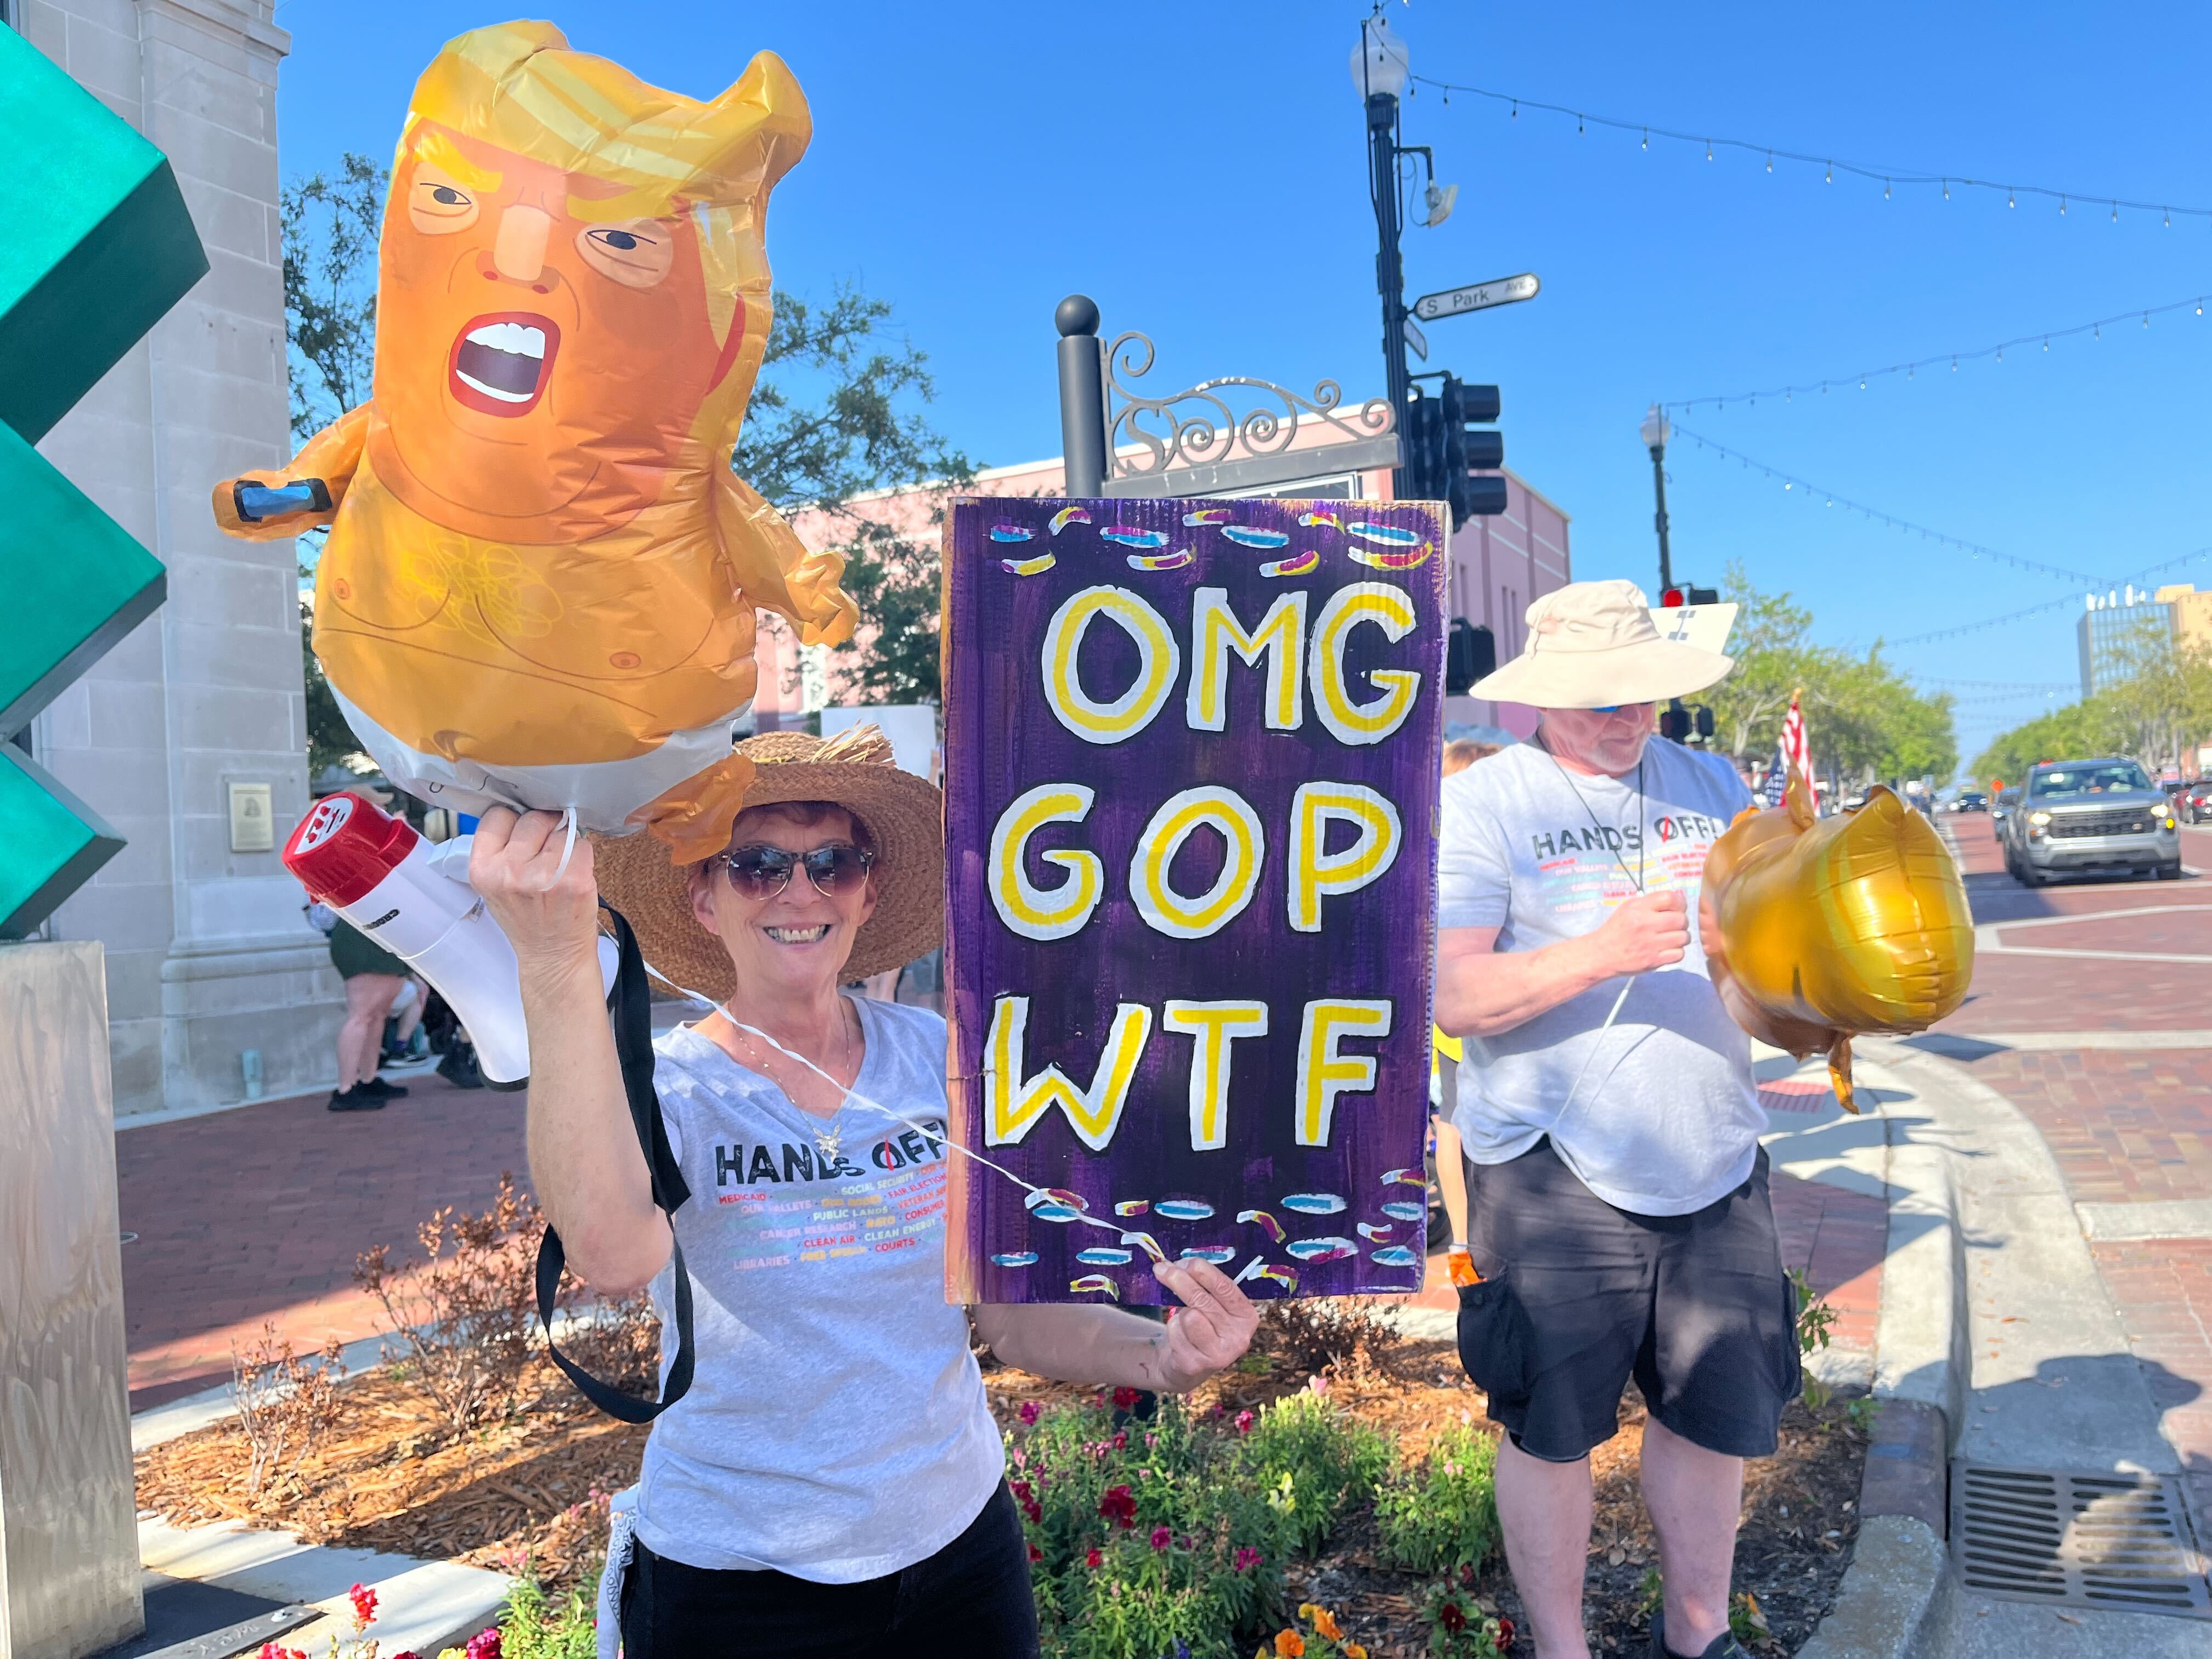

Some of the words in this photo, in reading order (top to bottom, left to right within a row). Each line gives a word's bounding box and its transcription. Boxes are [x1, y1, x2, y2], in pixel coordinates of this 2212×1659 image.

[1427, 300, 1438, 314] S
[1453, 289, 1489, 308] Park
[1042, 582, 1420, 744] OMG
[1532, 825, 1641, 859] HANDS
[988, 781, 1401, 940] GOP
[984, 994, 1392, 1151] WTF
[715, 1143, 866, 1186] HANDS
[719, 1193, 768, 1204] MEDICAID
[841, 1182, 875, 1195] SOCIAL
[877, 1171, 914, 1189] SECURITY
[741, 1204, 764, 1215] OUR
[888, 1188, 909, 1199] FAIR
[812, 1209, 849, 1221] PUBLIC
[852, 1205, 888, 1217] LANDS
[898, 1190, 934, 1209] VETERAN
[803, 1236, 836, 1248] CLEAN
[840, 1234, 855, 1245] AIR
[864, 1228, 900, 1242] CLEAN
[902, 1218, 936, 1234] ENERGY
[733, 1255, 791, 1271] LIBRARIES
[874, 1237, 916, 1253] COURTS
